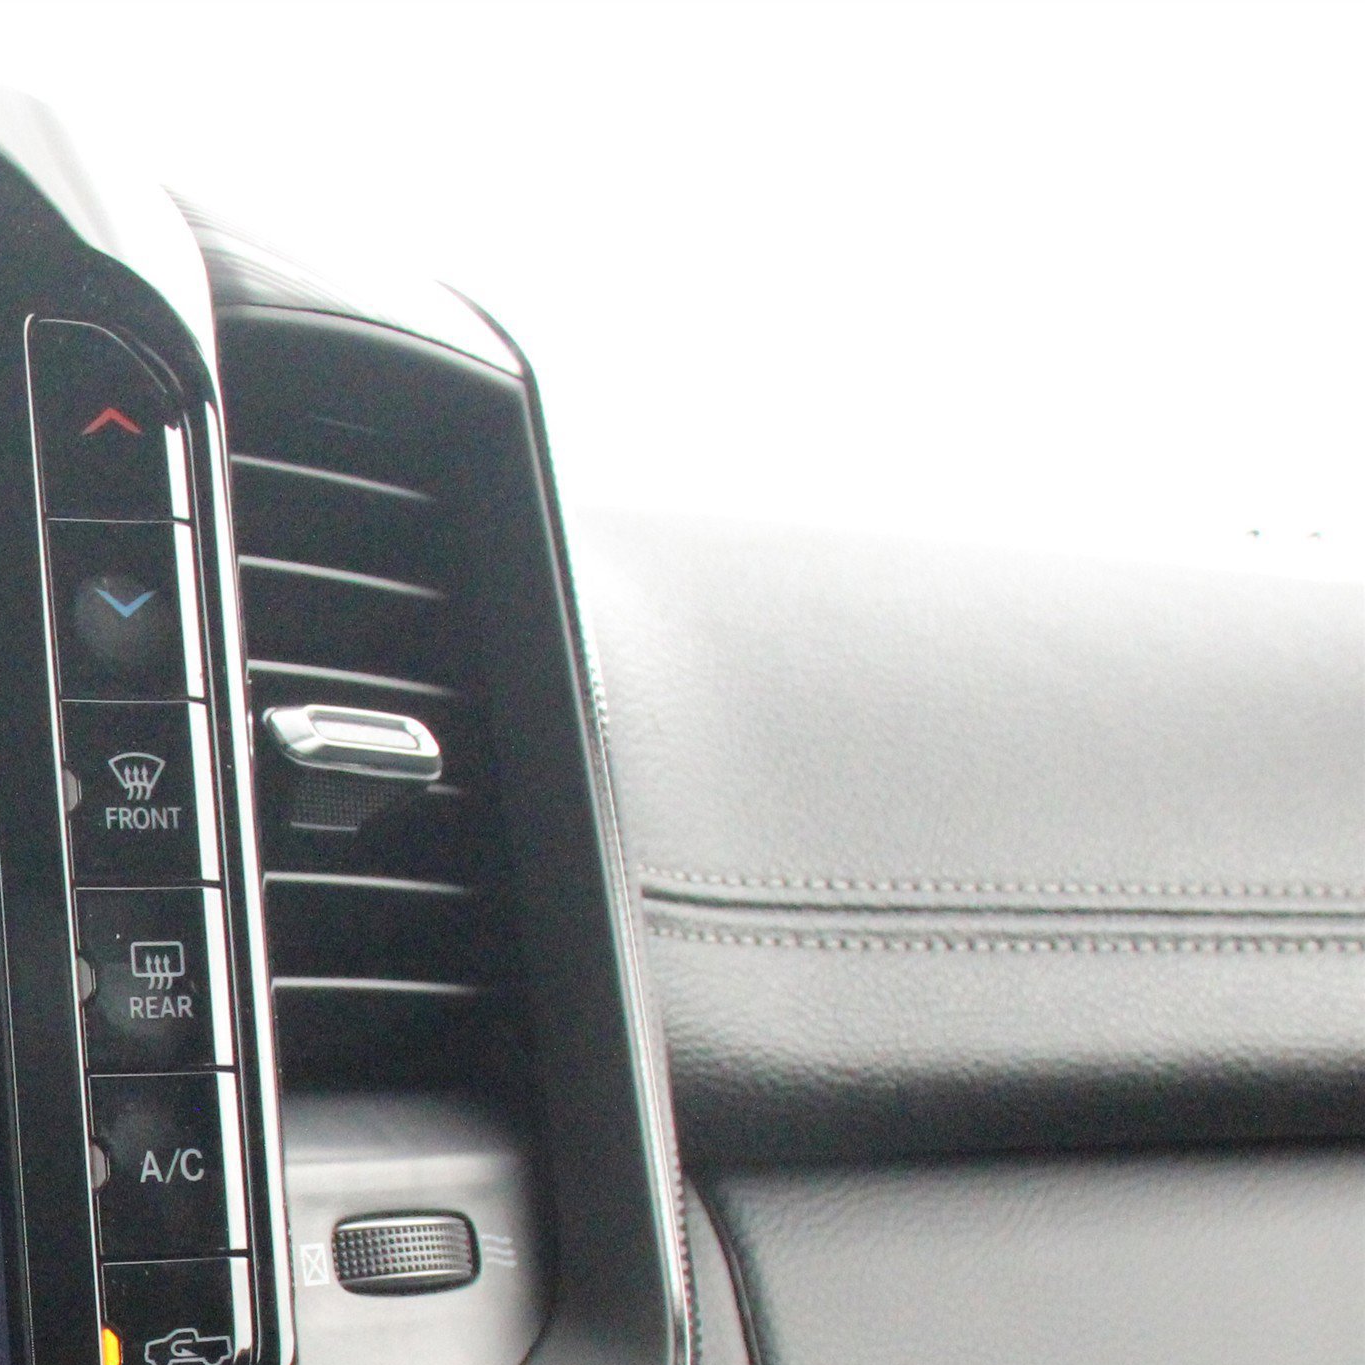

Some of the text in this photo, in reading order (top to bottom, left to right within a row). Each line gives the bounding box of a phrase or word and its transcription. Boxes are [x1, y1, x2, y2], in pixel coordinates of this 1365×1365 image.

[105, 807, 181, 832] FRONT
[129, 996, 193, 1019] REAR
[140, 1148, 204, 1183] A/C
